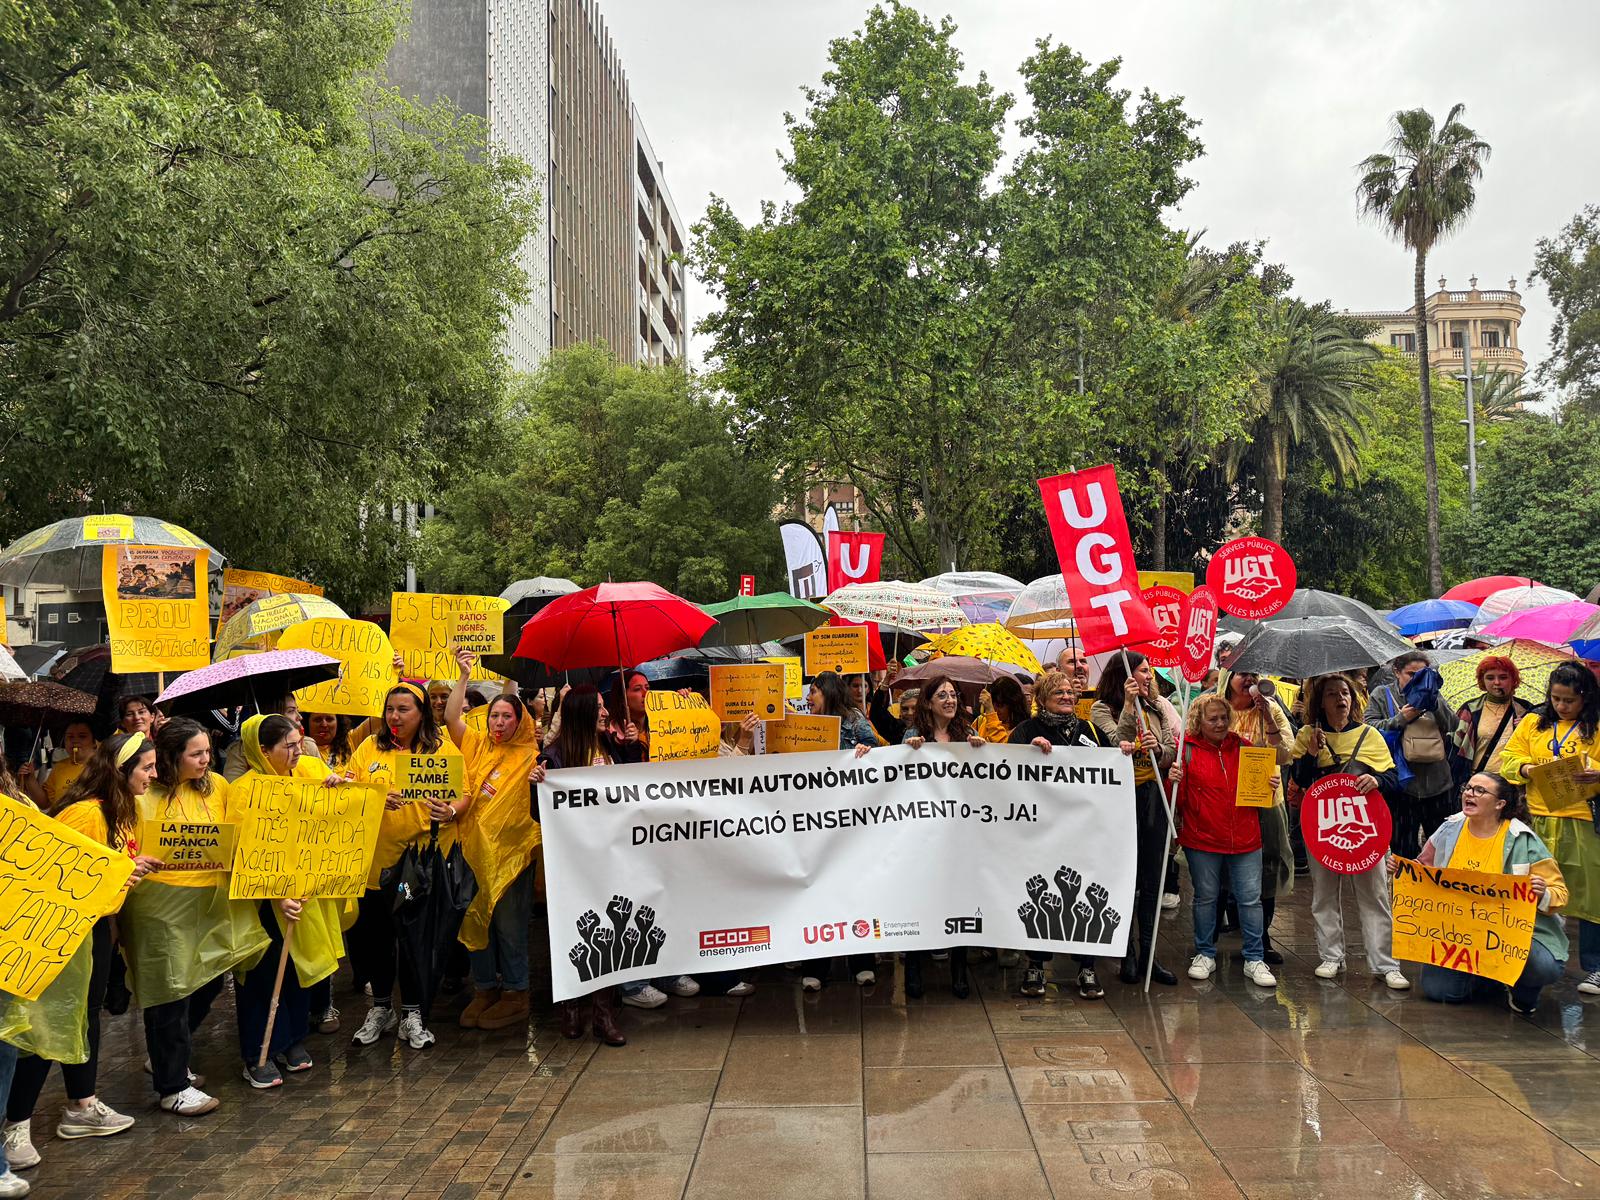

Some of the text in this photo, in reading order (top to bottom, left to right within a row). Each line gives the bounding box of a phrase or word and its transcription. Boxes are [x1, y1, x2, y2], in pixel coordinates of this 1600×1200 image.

[1058, 481, 1132, 637] UGT
[1219, 540, 1276, 559] SERVEIS PÚBLICS
[1224, 554, 1274, 582] UGT
[120, 602, 191, 629] PROU
[396, 593, 419, 623] ÉS
[458, 611, 487, 621] RÀTIOS
[1227, 599, 1283, 617] ILLES BALEARS
[1188, 607, 1213, 635] UGT
[112, 633, 209, 657] EXPLOTACIÓ
[452, 633, 496, 643] ATENCIÓ DE
[459, 645, 492, 653] UALITAT
[410, 757, 448, 769] EL 0-3
[408, 771, 449, 784] TAMBÉ
[553, 759, 1122, 810] PER UN CONVENI AUTONÒMIC D'EDUCACIÓ INFANTIL
[1311, 779, 1339, 799] SERVEIS
[248, 778, 293, 815] MÉS
[298, 783, 350, 817] MANS
[632, 800, 1038, 846] DIGNIFICACIÓ ENSENYAMENT 0-3, JA!
[1318, 796, 1370, 829] UGT
[161, 823, 220, 834] LA PETITA
[255, 815, 366, 846] MÉS MIRADA
[159, 835, 219, 847] INFÀNCIA
[173, 848, 202, 860] SÍ ÉS
[240, 846, 364, 873] VOLEM LA PETITA
[1321, 850, 1380, 872] ILLES BALEARS
[1395, 860, 1423, 883] Mi
[1424, 867, 1511, 900] Vocación
[1, 888, 97, 957] TAMBÉ
[1393, 893, 1534, 933] paga mis facturas
[803, 921, 848, 945] UGT
[944, 916, 983, 935] STEI
[699, 942, 771, 957] ensenyament
[703, 930, 750, 946] CCOO
[1395, 914, 1529, 965] Sueldos Dignos
[1430, 939, 1481, 974] ¡YA!
